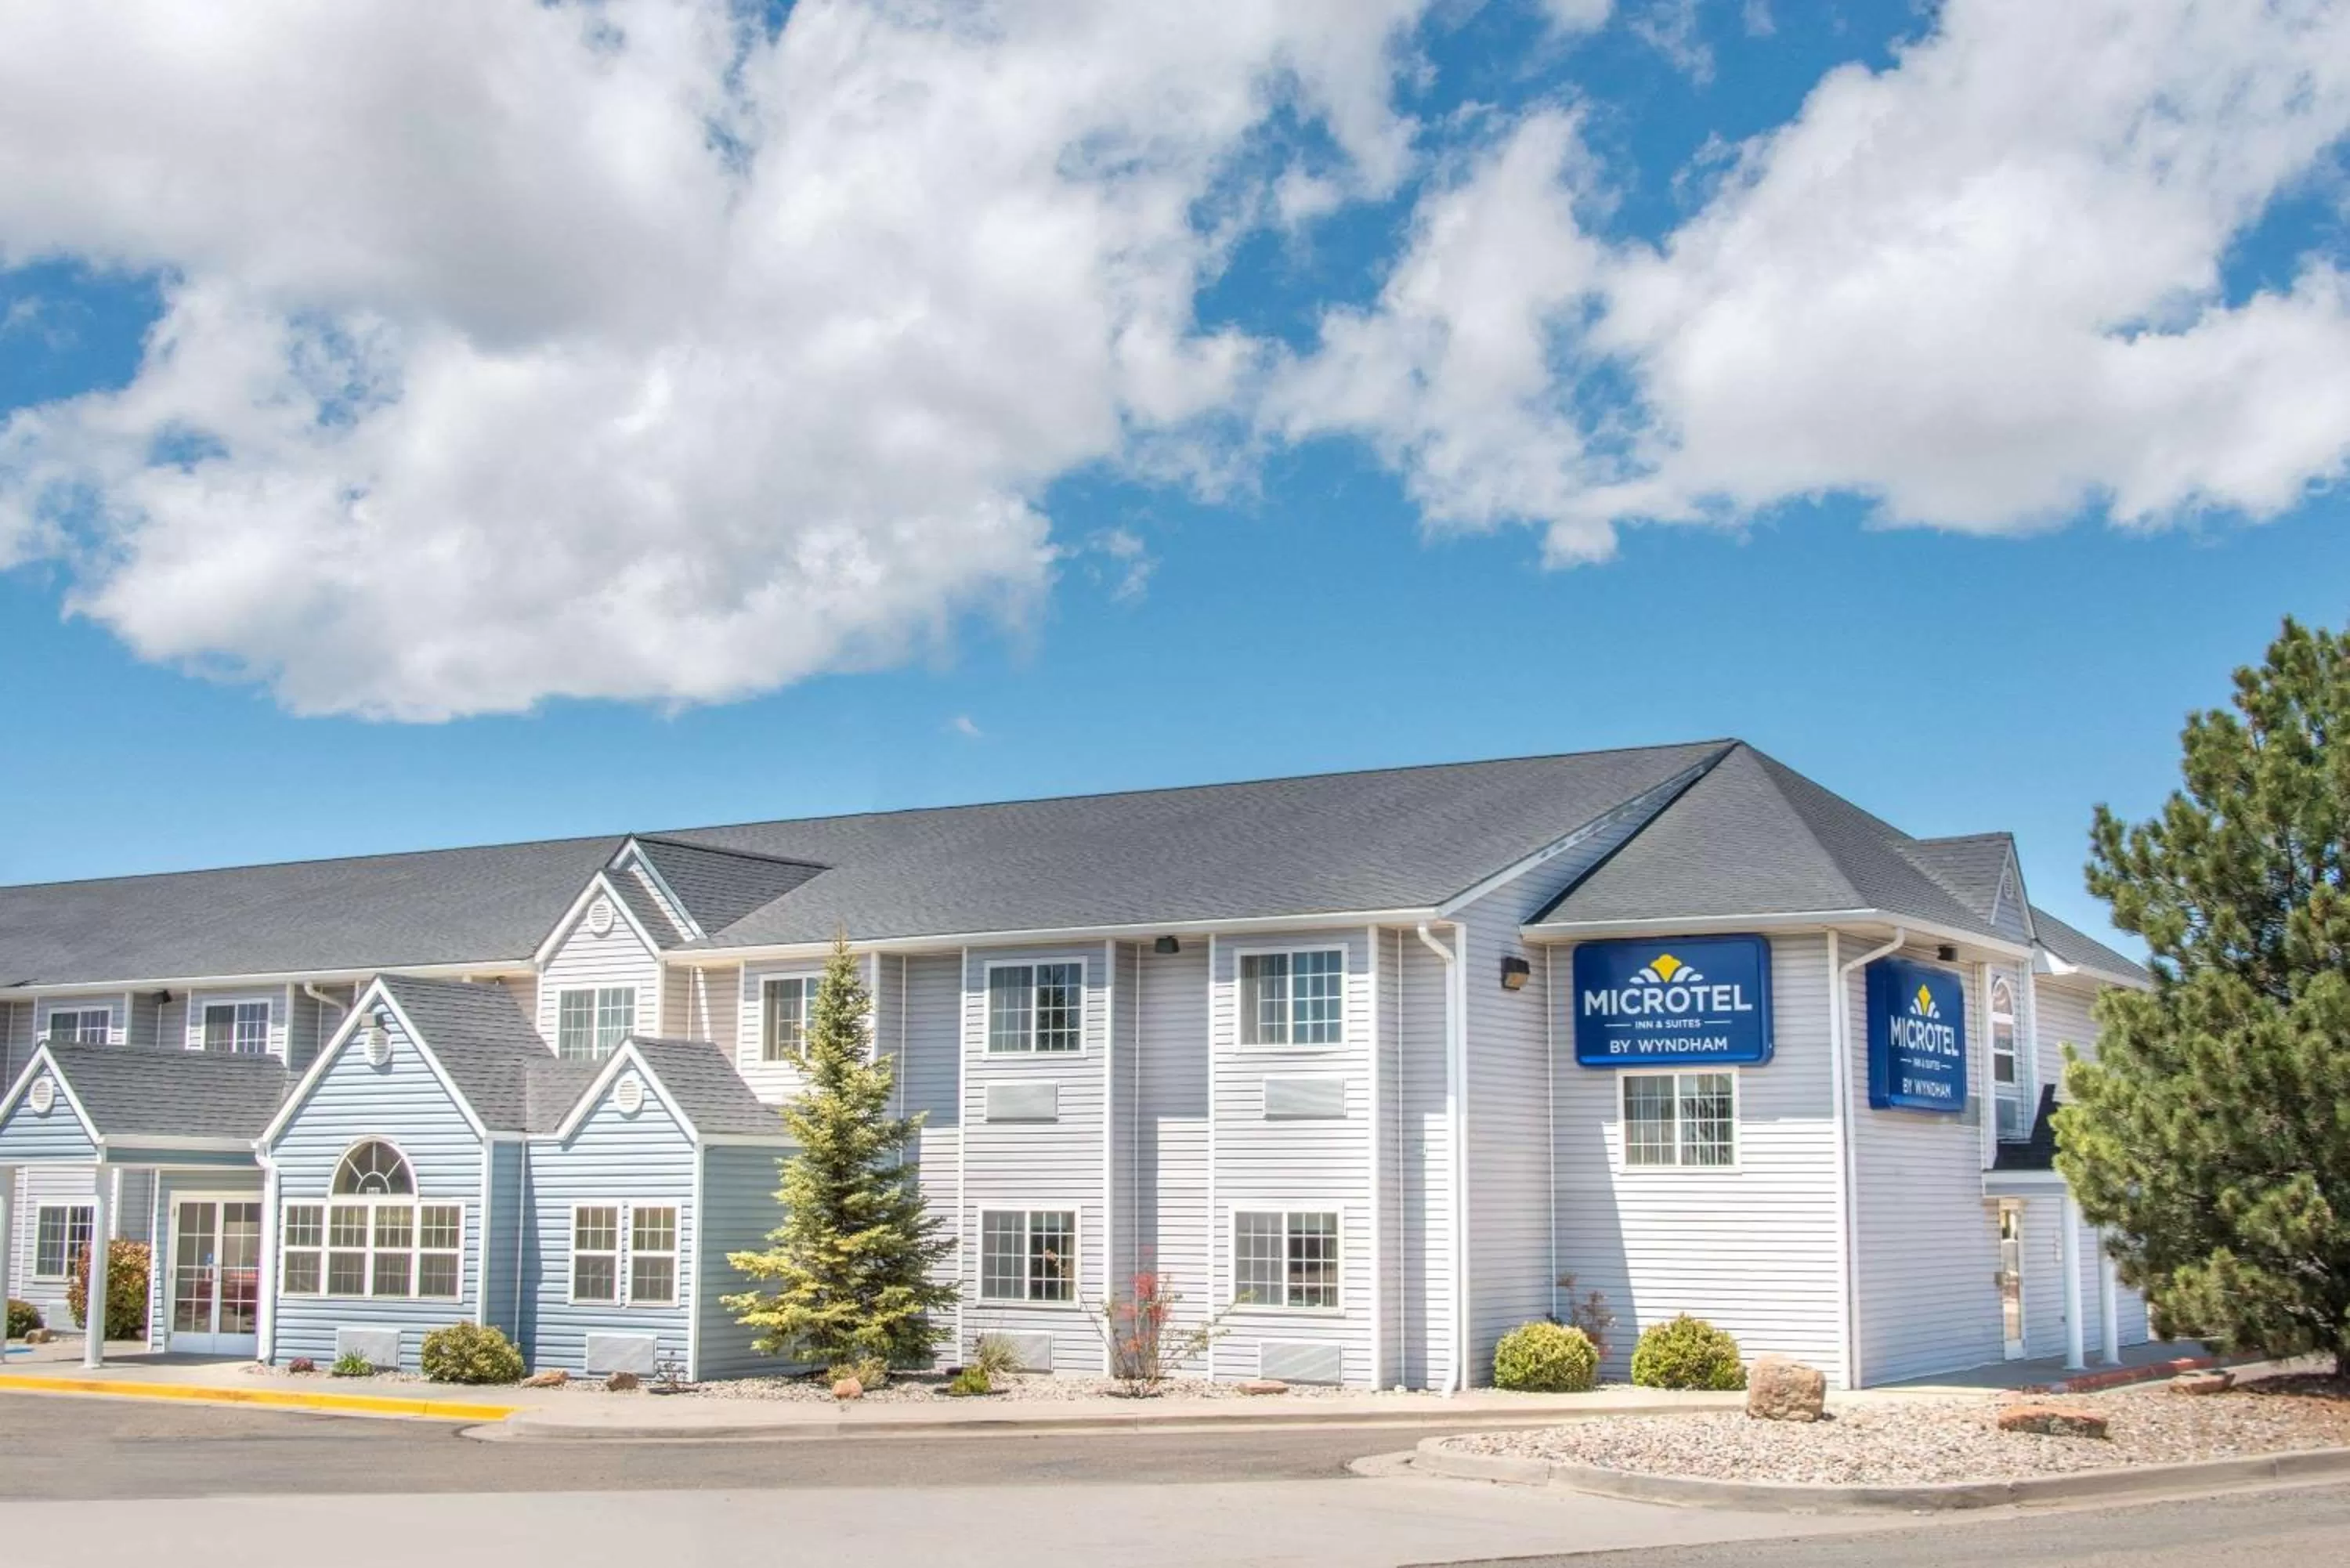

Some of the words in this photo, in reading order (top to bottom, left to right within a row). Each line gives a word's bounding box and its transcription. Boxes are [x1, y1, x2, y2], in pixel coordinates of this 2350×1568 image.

[1584, 985, 1752, 1016] MICROTEL
[1635, 1021, 1654, 1029] INN
[1655, 1020, 1663, 1028] &
[1665, 1019, 1701, 1028] SUITES
[1610, 1039, 1631, 1053] BY
[1638, 1036, 1728, 1053] WYNDHAM
[1890, 1015, 1959, 1057] MICROTEL
[1914, 1078, 1951, 1098] WYNDHAM
